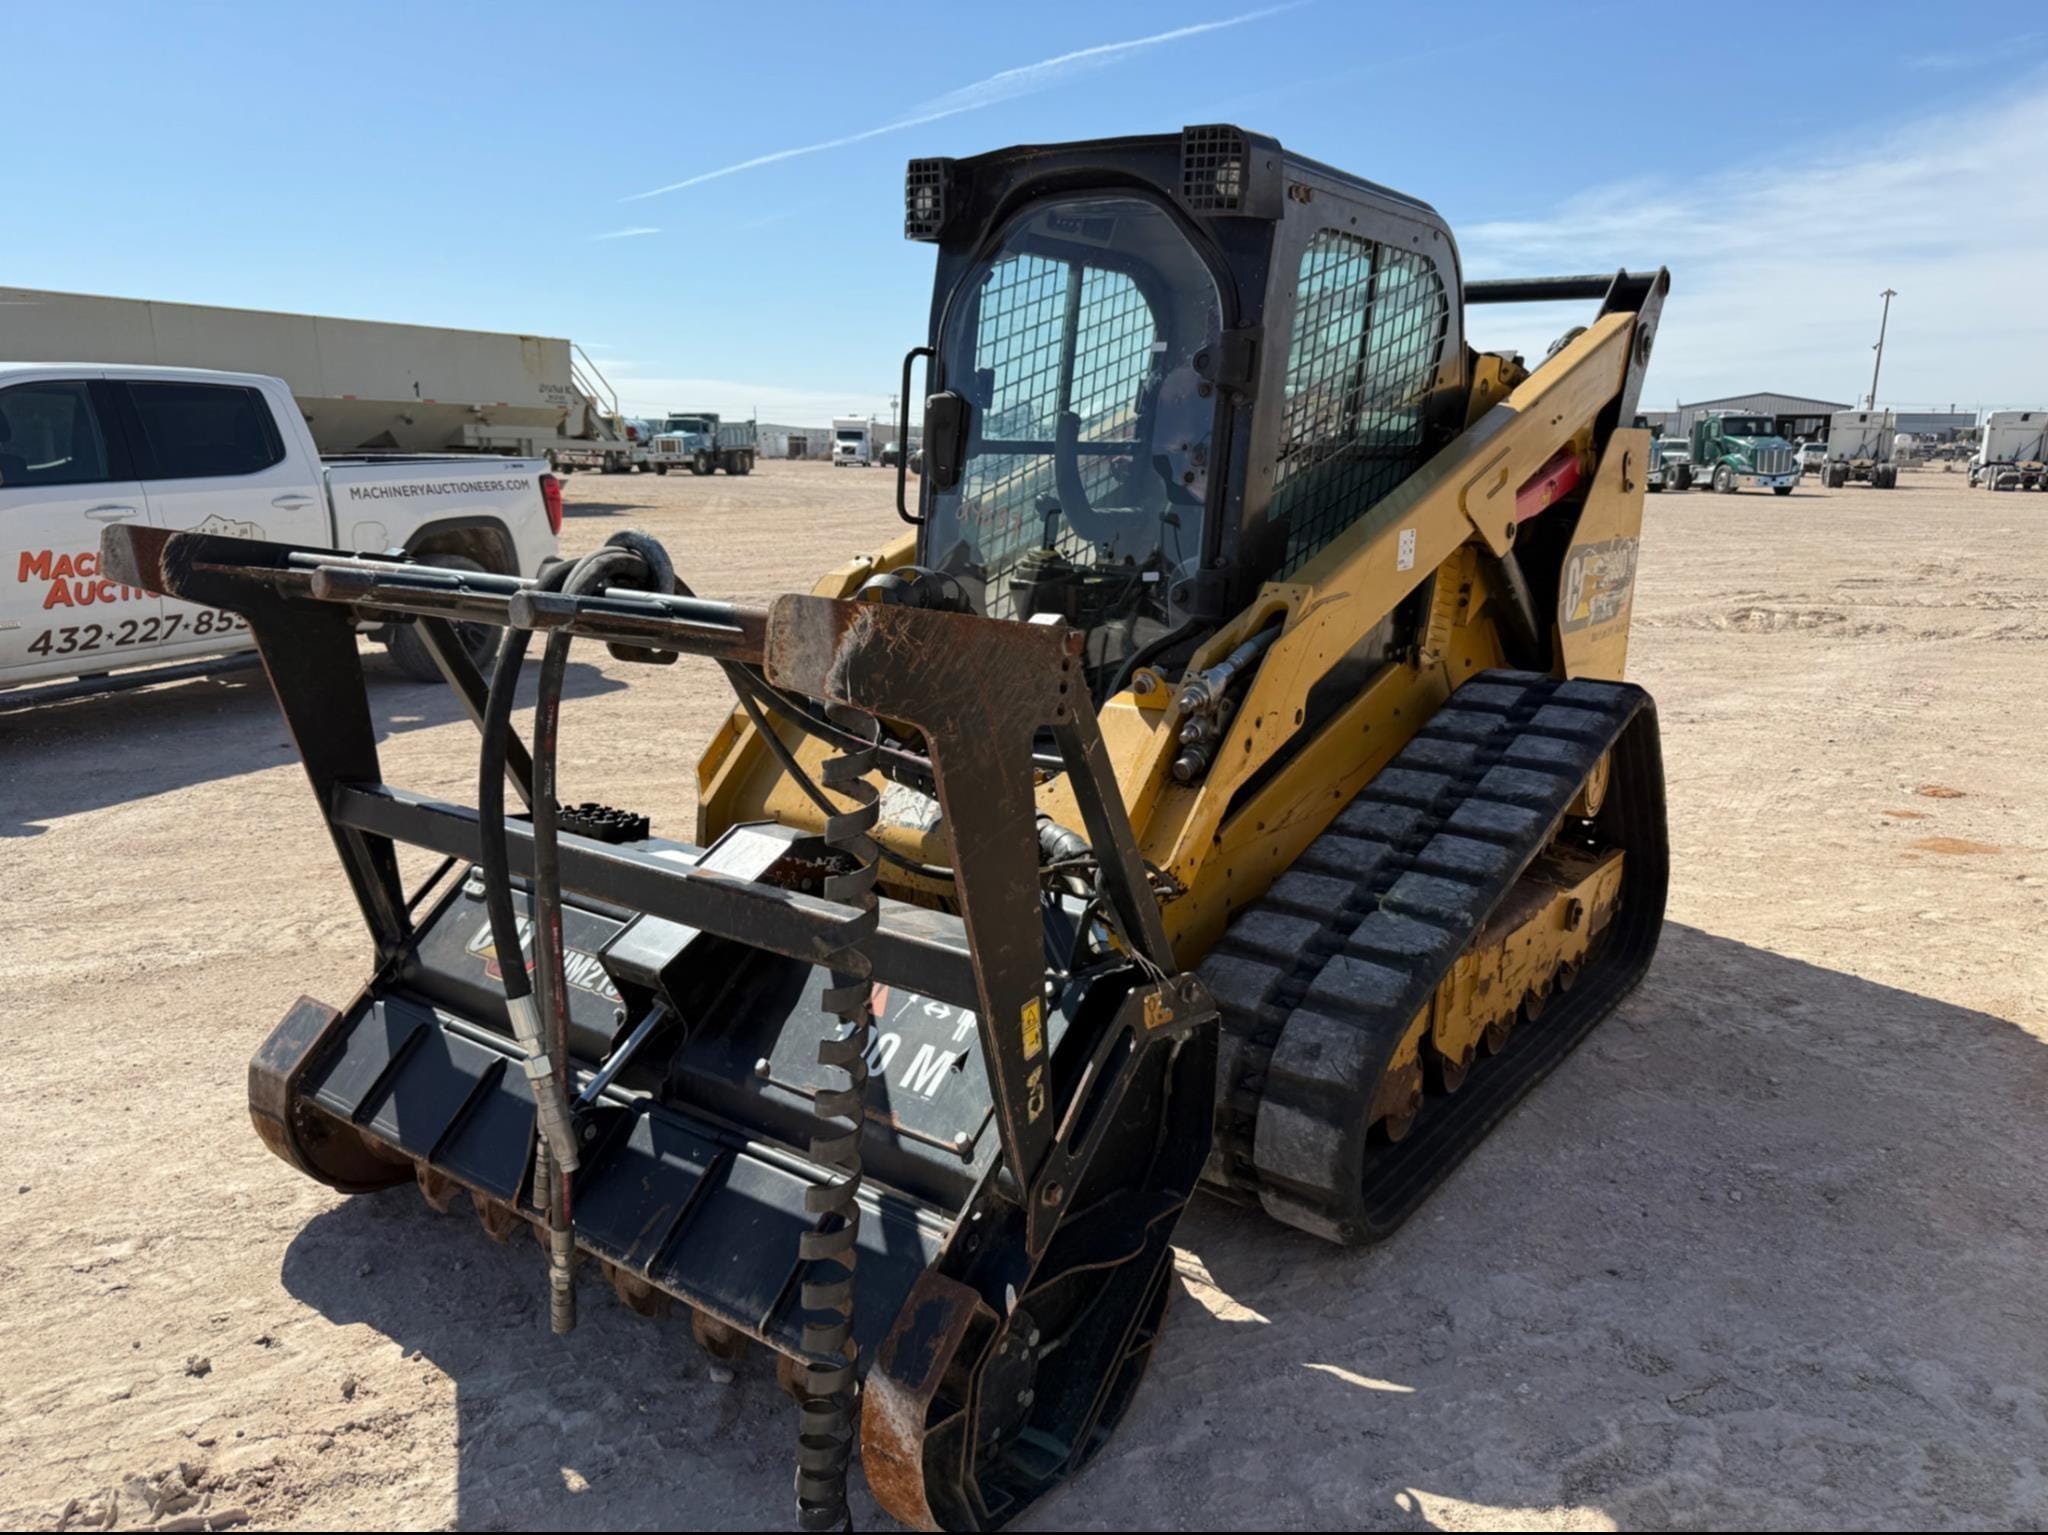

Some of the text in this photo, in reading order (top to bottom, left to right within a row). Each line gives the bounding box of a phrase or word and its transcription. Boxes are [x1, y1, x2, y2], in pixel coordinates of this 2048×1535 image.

[350, 479, 530, 500] MACHINERYAUCTIONEERS.COM
[43, 578, 161, 610] AUC
[28, 624, 103, 656] 432
[115, 614, 183, 647] 227
[899, 1043, 957, 1098] M
